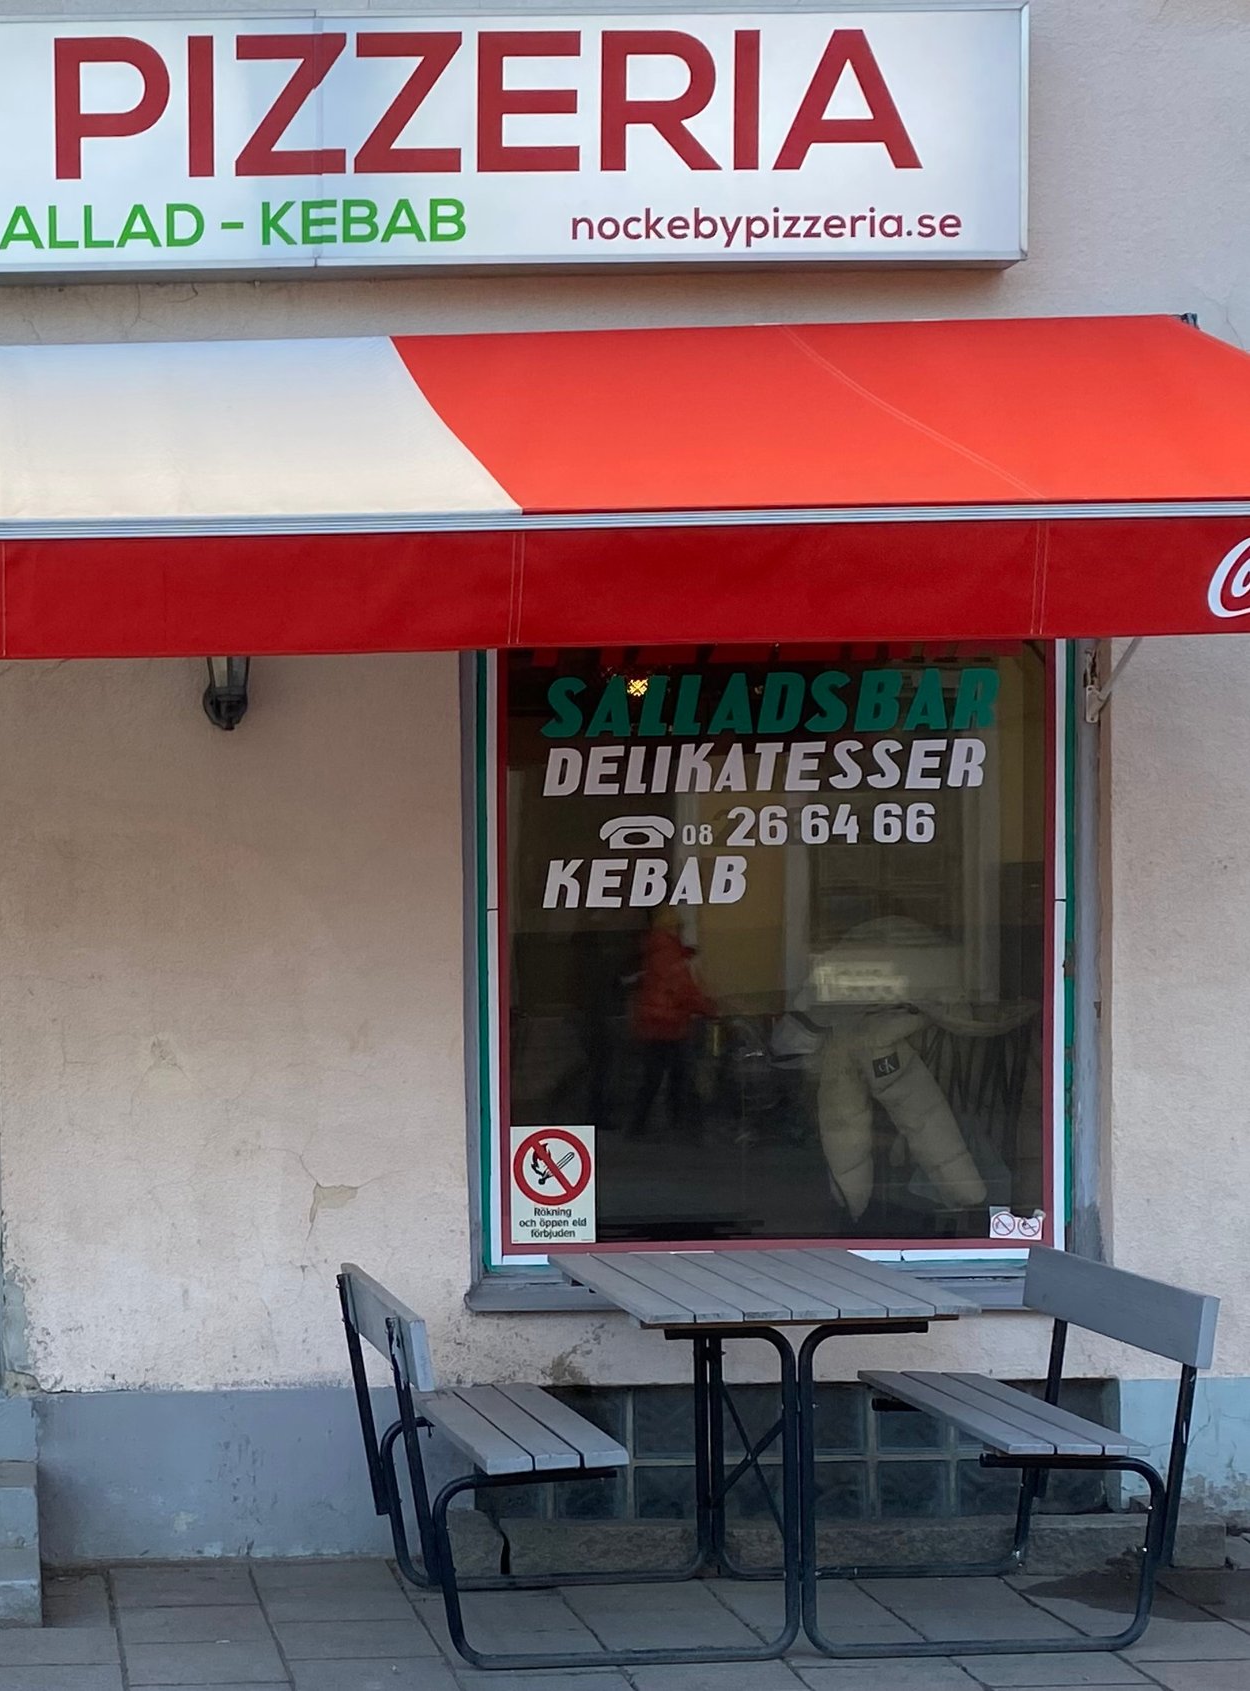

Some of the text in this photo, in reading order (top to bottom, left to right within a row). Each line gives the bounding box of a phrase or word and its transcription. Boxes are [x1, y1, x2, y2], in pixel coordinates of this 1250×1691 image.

[53, 28, 922, 181] PIZZERIA
[261, 197, 467, 247] KEBAB
[570, 207, 962, 248] nockebypizzeria.se
[541, 667, 1001, 738] SALLADSBAR
[542, 738, 988, 797] DELIKATESSER
[682, 802, 936, 847] 08 26 64 66
[542, 855, 748, 909] KEBAB
[519, 1217, 587, 1229] och öppen eld
[530, 1228, 576, 1240] förbjuden
[534, 1207, 572, 1218] Rökning
